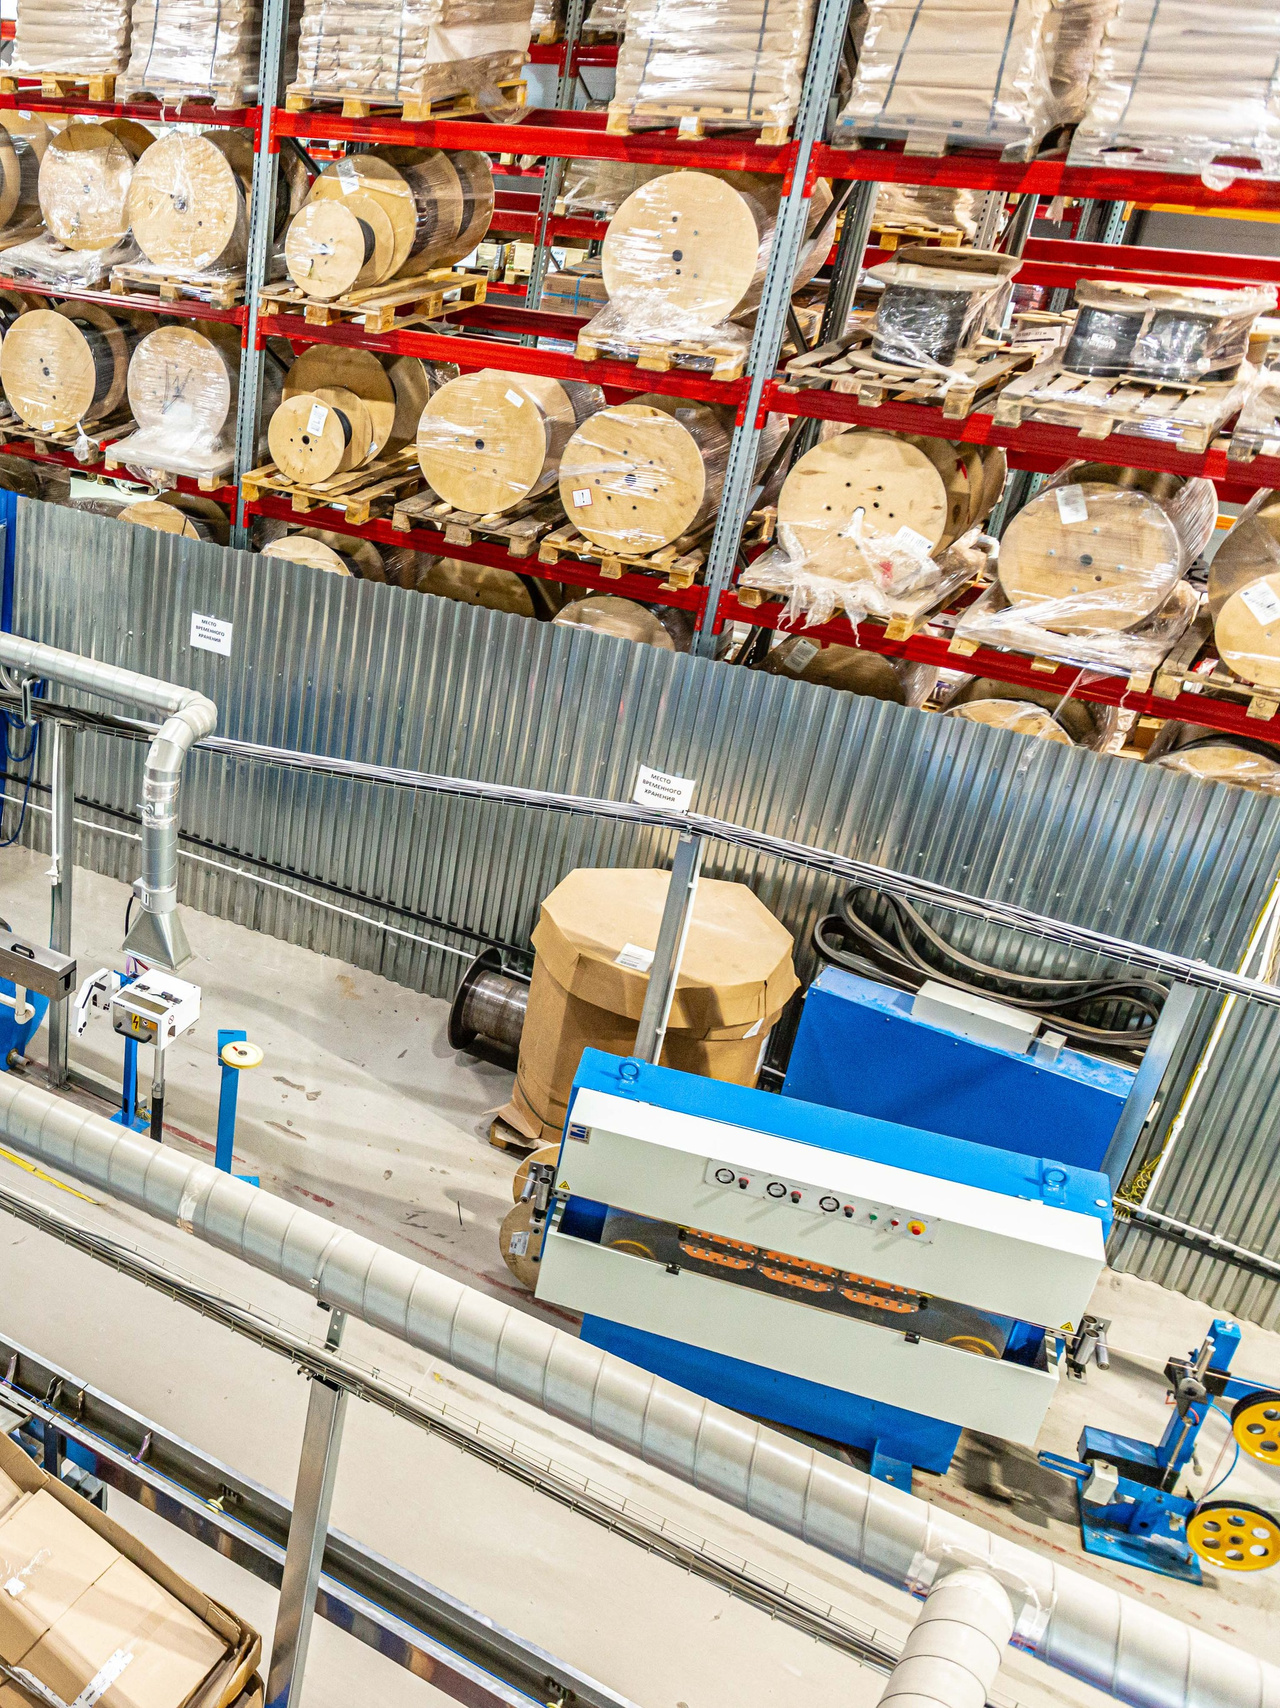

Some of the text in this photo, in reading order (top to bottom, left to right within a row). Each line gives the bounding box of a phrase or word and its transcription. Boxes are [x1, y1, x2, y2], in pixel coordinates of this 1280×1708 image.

[201, 619, 217, 627] МЕСТО
[195, 625, 225, 637] ВРЕМЕННОГО
[198, 633, 222, 643] ХРАНЕНИЯ
[650, 773, 672, 785] МЕСТО
[642, 778, 682, 796] ВРЕМЕННОГО
[644, 788, 676, 802] ХРАНЕНИЯ
